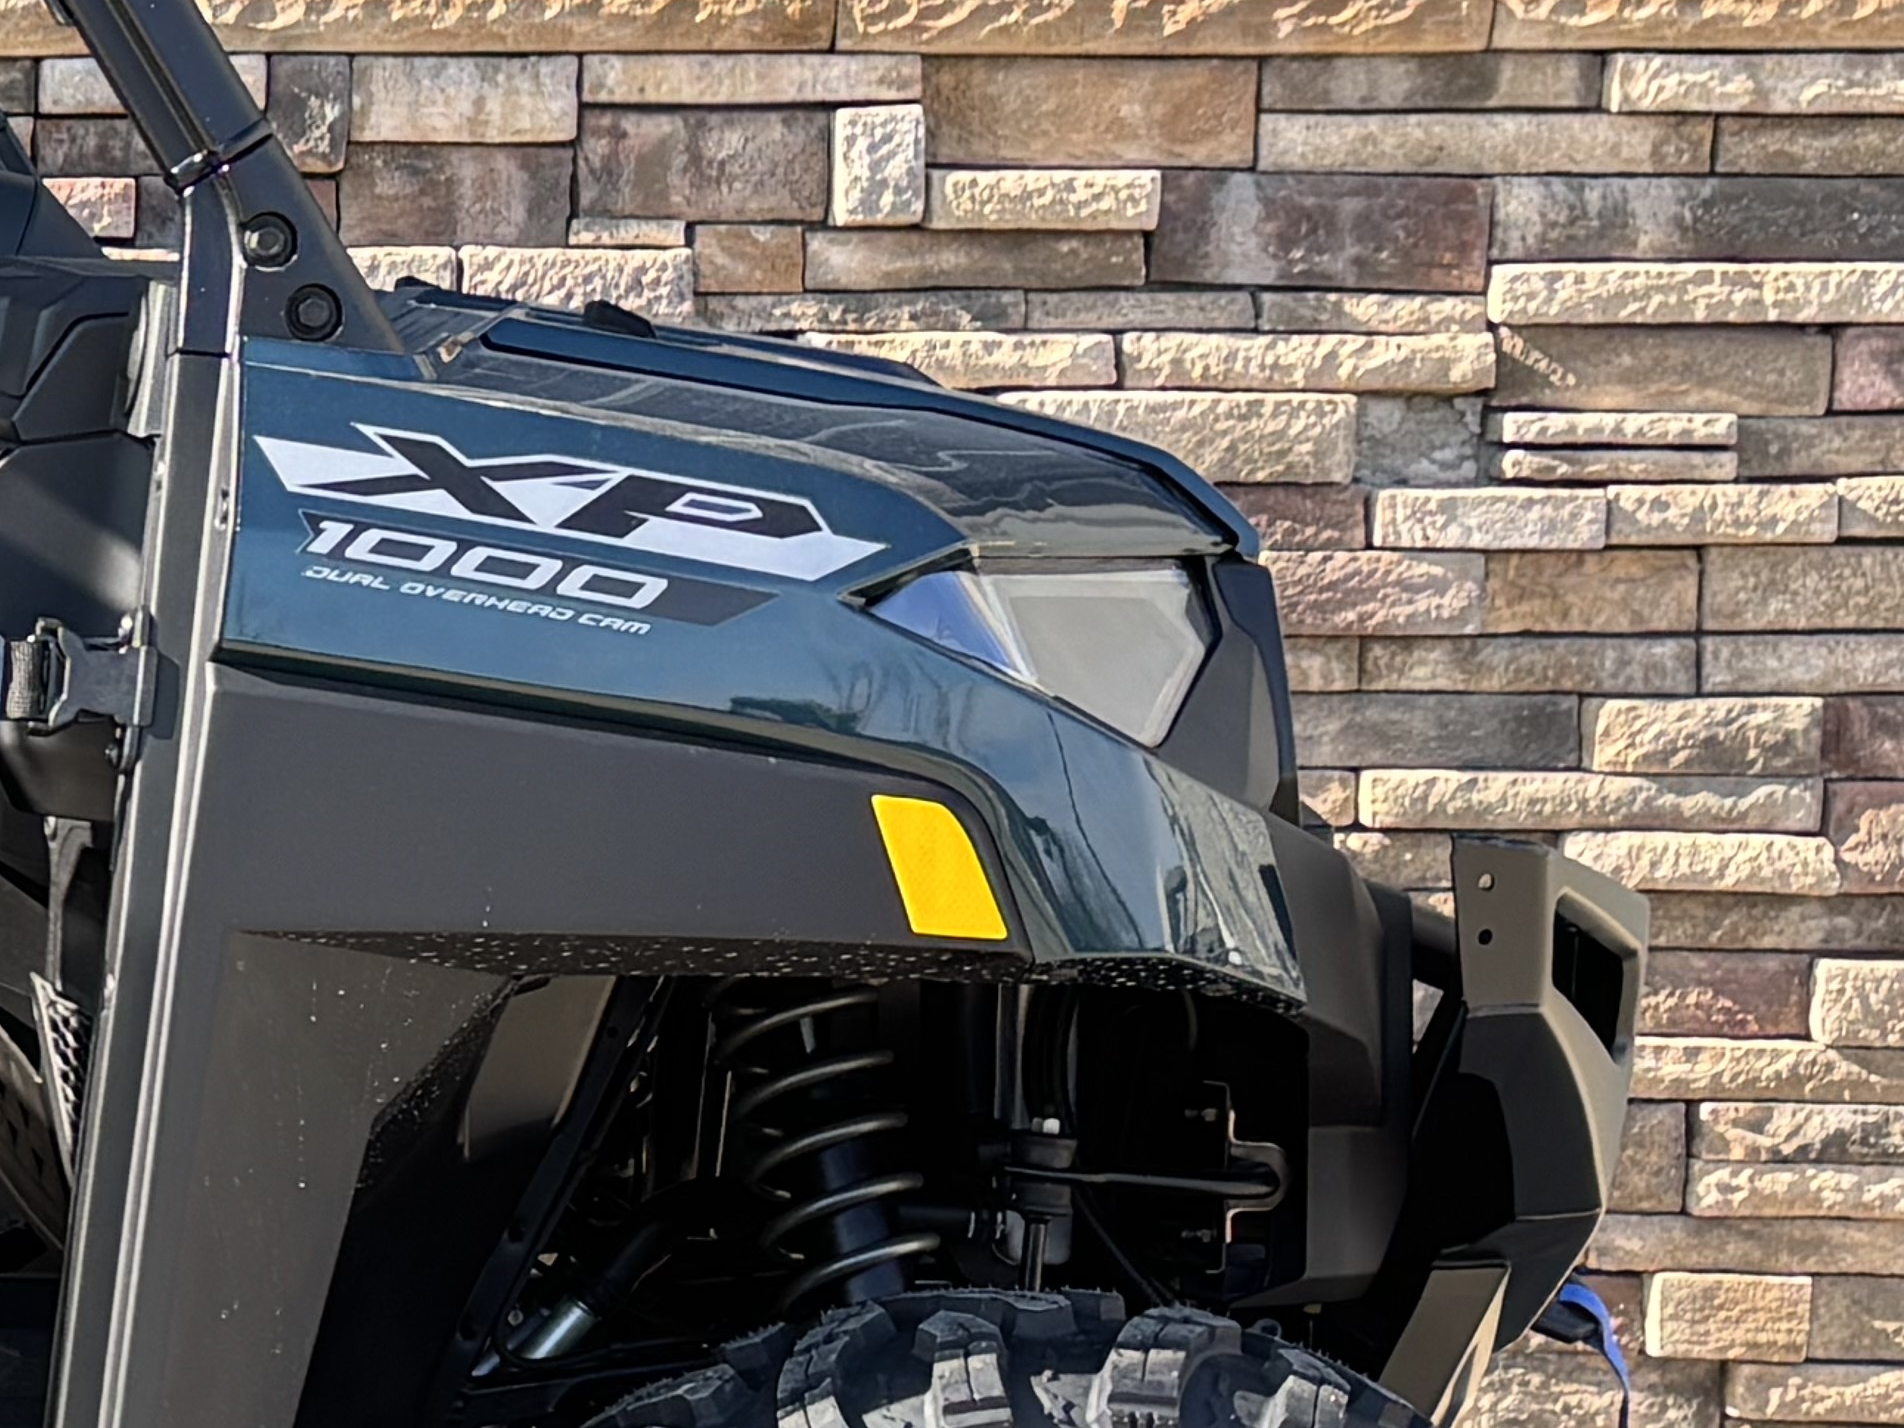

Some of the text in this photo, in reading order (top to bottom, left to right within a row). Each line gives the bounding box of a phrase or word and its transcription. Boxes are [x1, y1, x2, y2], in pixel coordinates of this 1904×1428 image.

[300, 422, 834, 539] XP
[304, 565, 652, 635] DUAL OVERHEAD CAM
[306, 519, 669, 609] 1000
